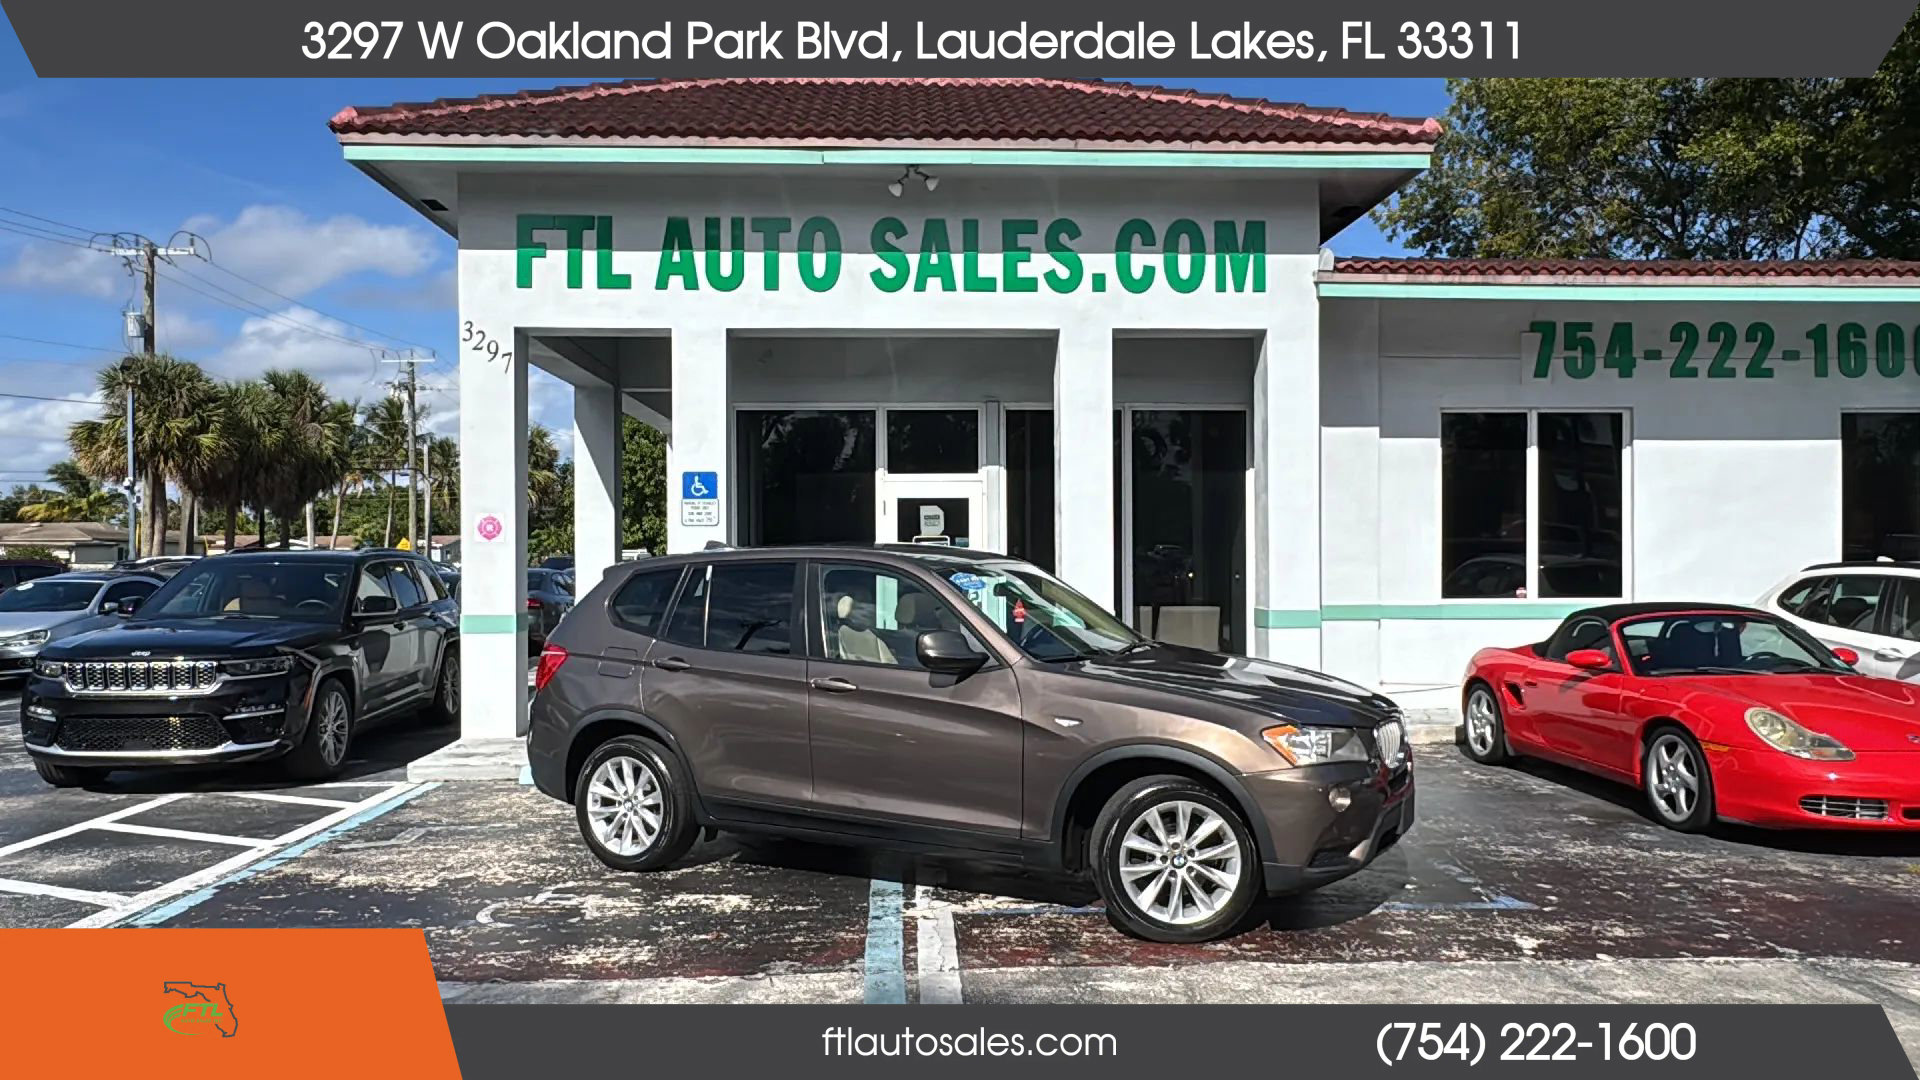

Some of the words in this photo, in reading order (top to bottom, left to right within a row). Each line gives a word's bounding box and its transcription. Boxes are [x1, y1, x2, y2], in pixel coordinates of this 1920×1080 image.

[515, 214, 633, 290] FTL
[655, 215, 843, 293] AUTO
[869, 216, 1267, 294] SALES.COM
[462, 320, 513, 374] 3297
[1529, 320, 1920, 380] 754-222-160
